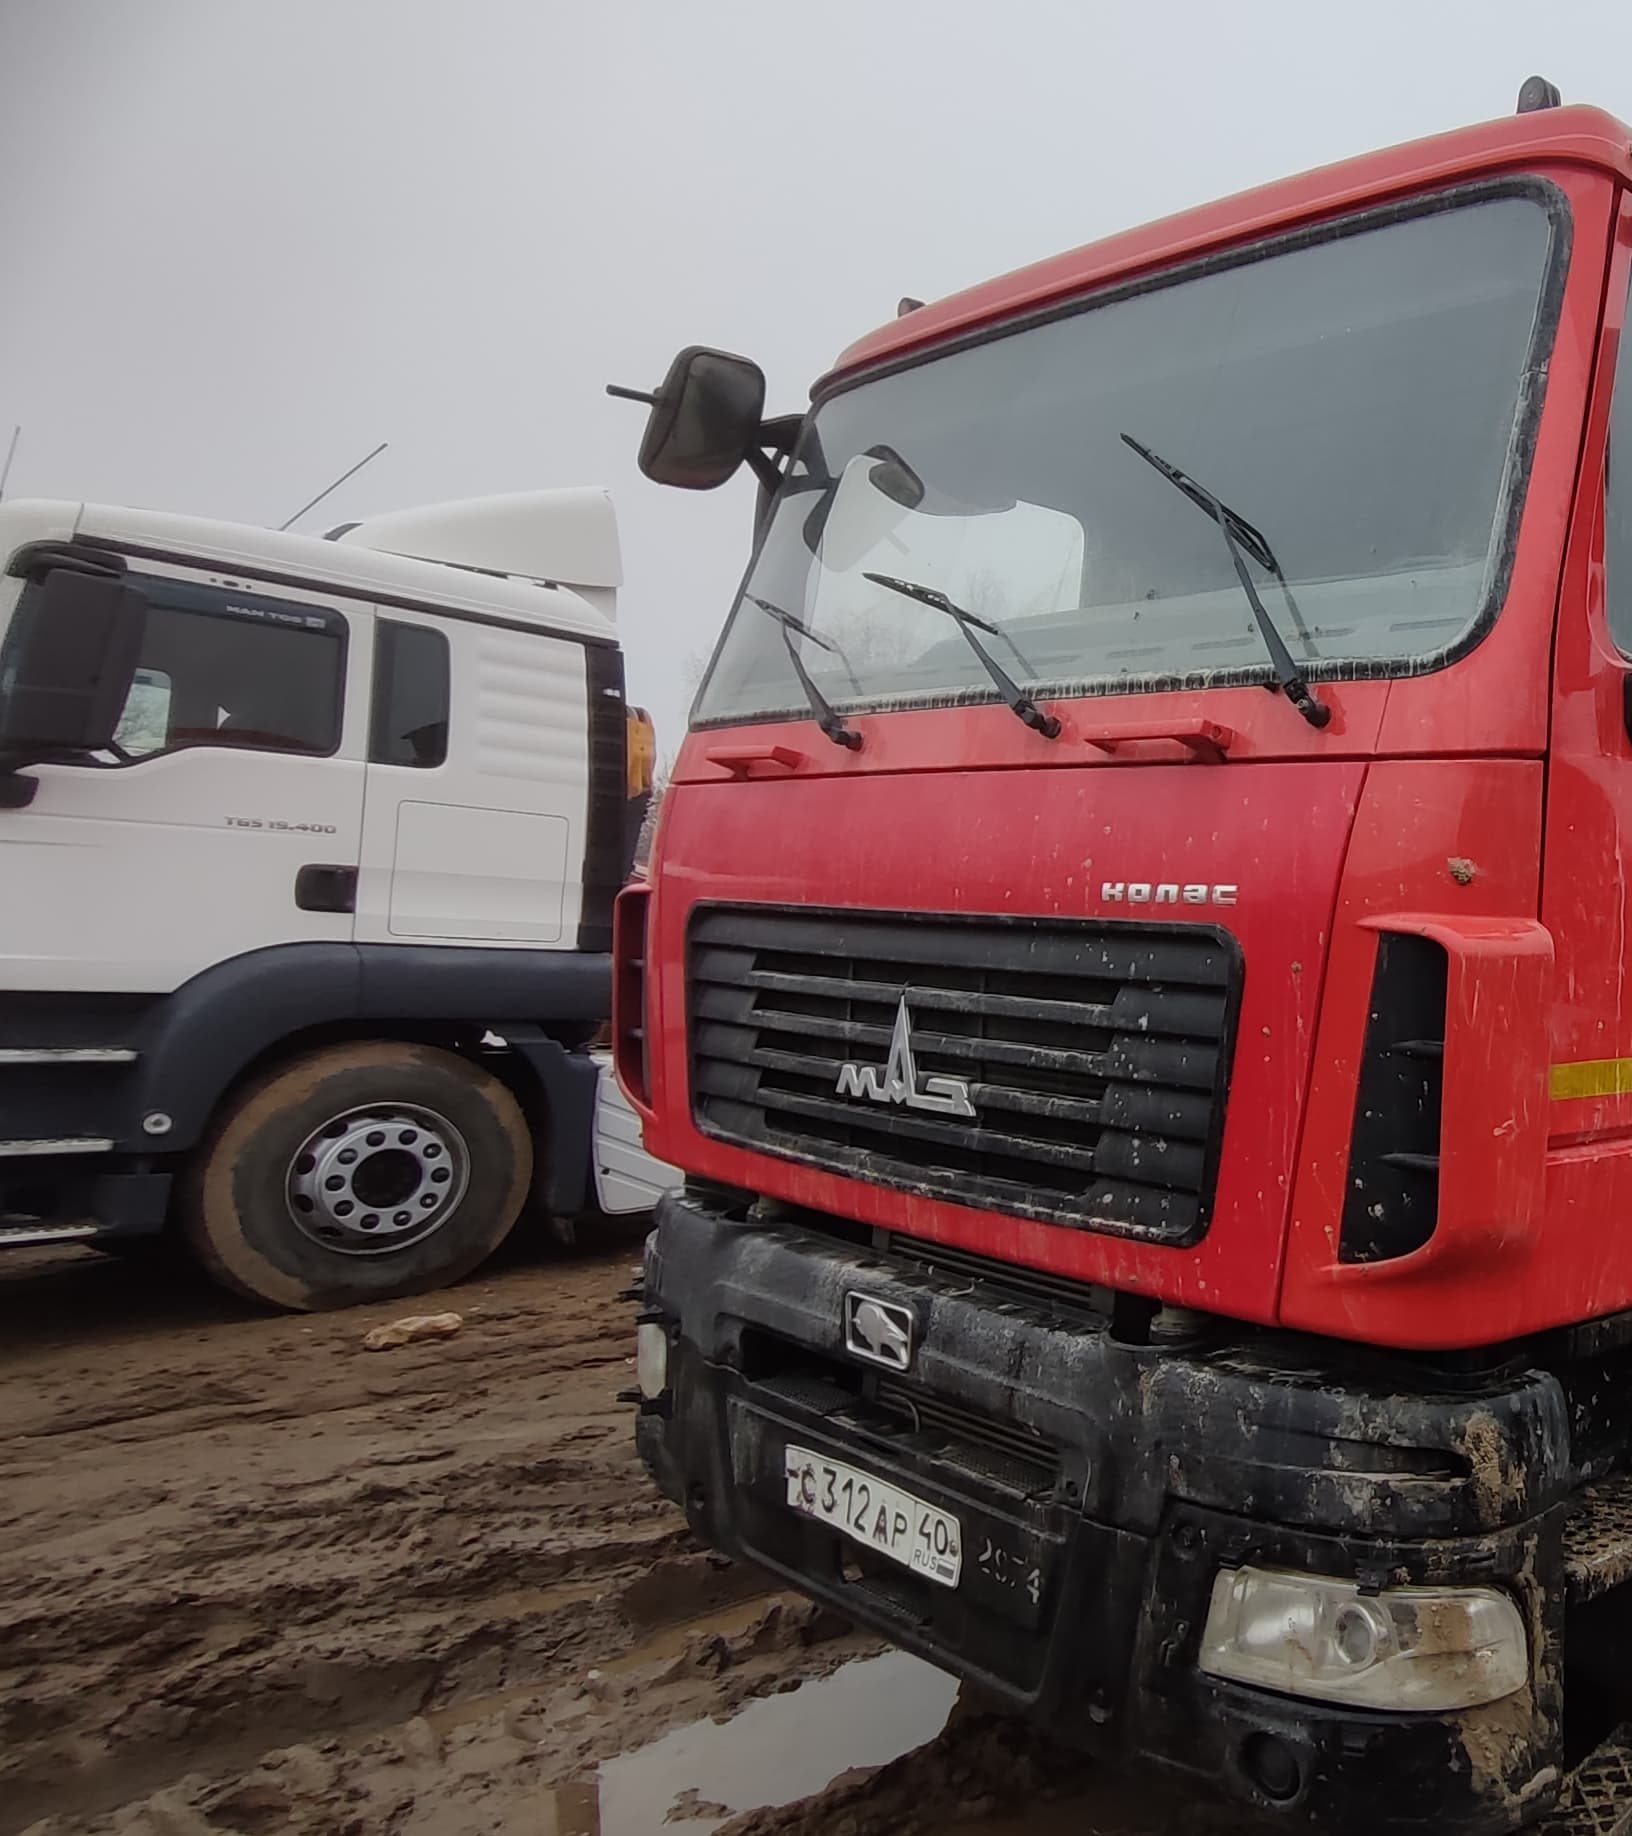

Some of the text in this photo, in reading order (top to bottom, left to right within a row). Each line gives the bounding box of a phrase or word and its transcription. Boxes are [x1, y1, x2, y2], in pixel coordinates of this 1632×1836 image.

[224, 816, 263, 828] TGS
[918, 1512, 949, 1556] 40
[913, 1548, 938, 1571] RUS
